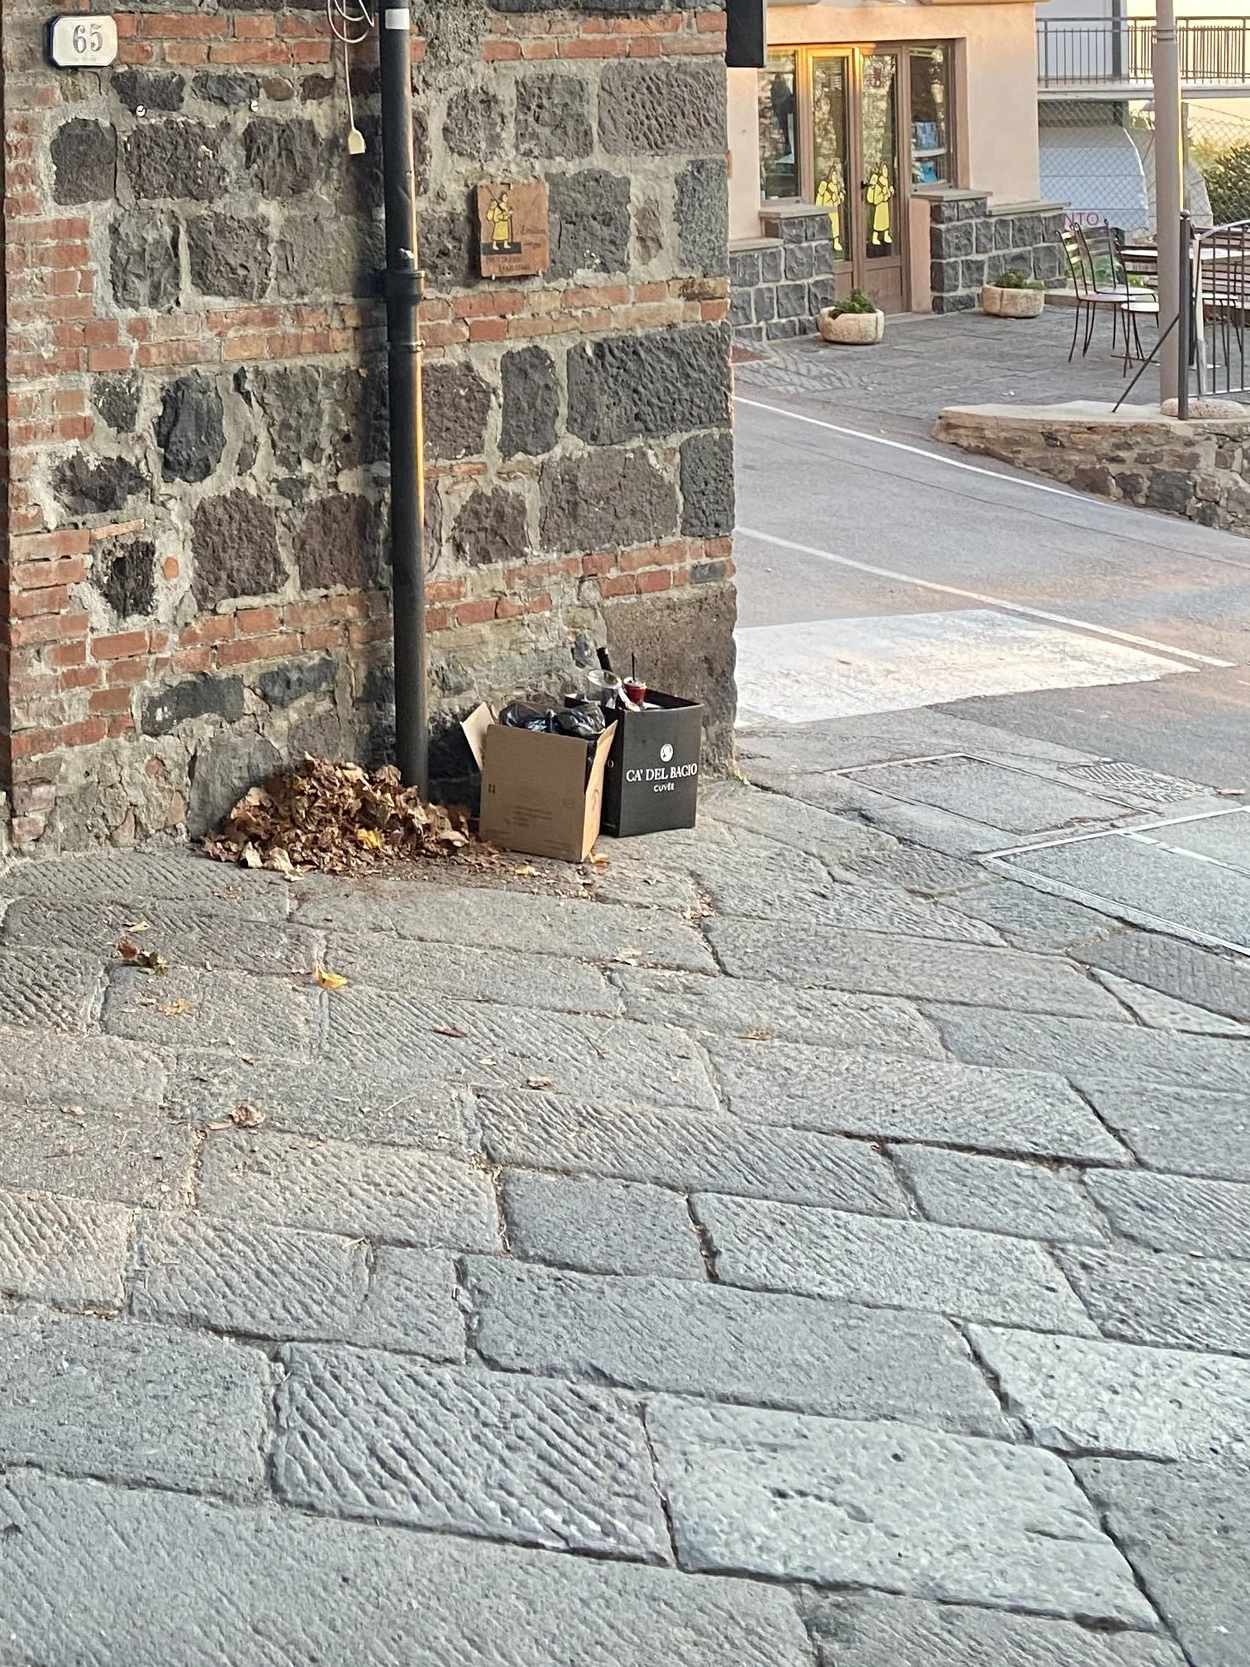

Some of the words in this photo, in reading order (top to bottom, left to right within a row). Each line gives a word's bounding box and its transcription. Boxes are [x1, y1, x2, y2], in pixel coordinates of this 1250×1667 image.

[72, 23, 104, 54] 65
[645, 767, 669, 781] DEL
[670, 763, 698, 779] BACIO
